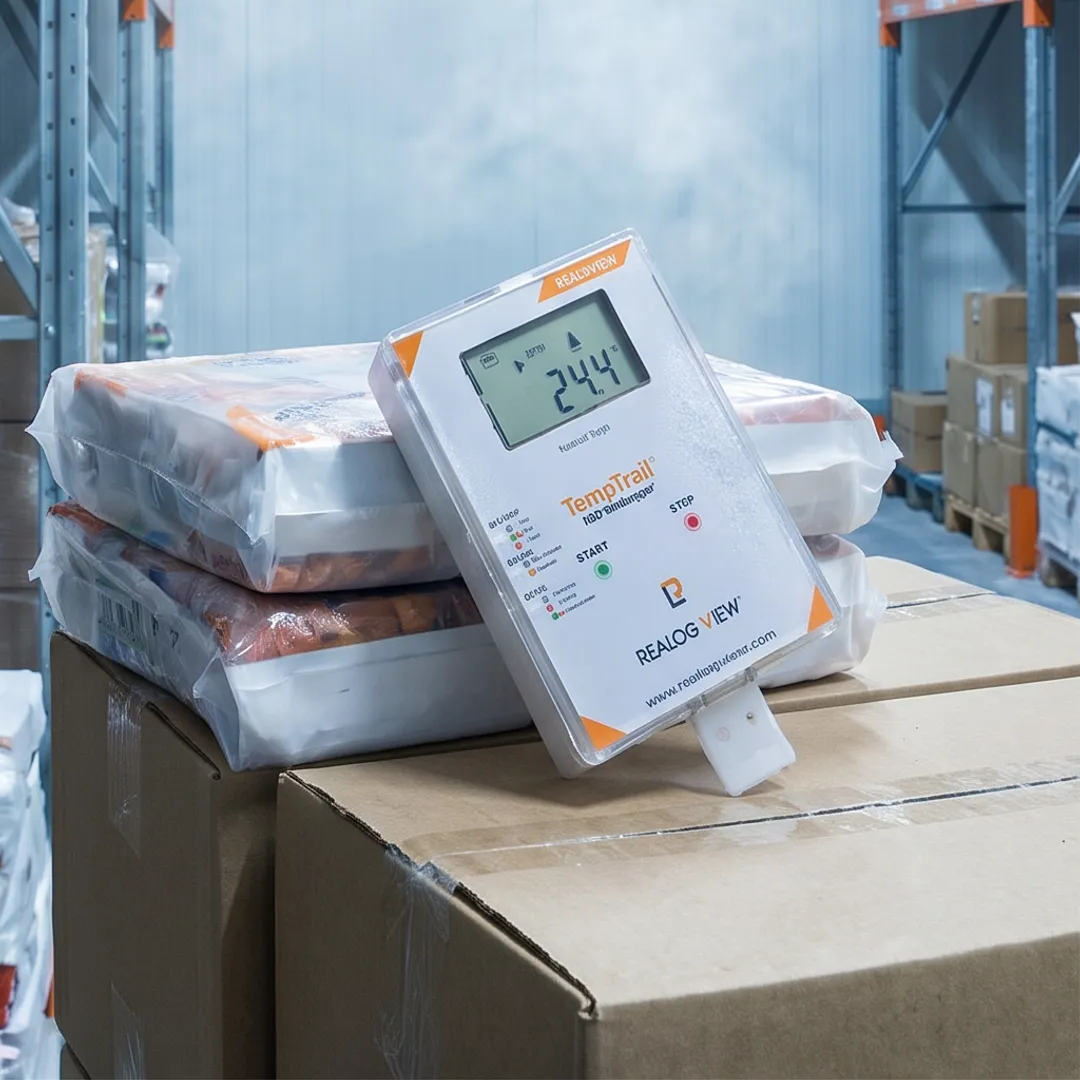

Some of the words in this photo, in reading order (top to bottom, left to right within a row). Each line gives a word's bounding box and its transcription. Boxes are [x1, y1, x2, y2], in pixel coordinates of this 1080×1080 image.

[560, 458, 655, 517] TempTrail
[576, 540, 609, 563] START
[635, 622, 700, 666] REALOG
